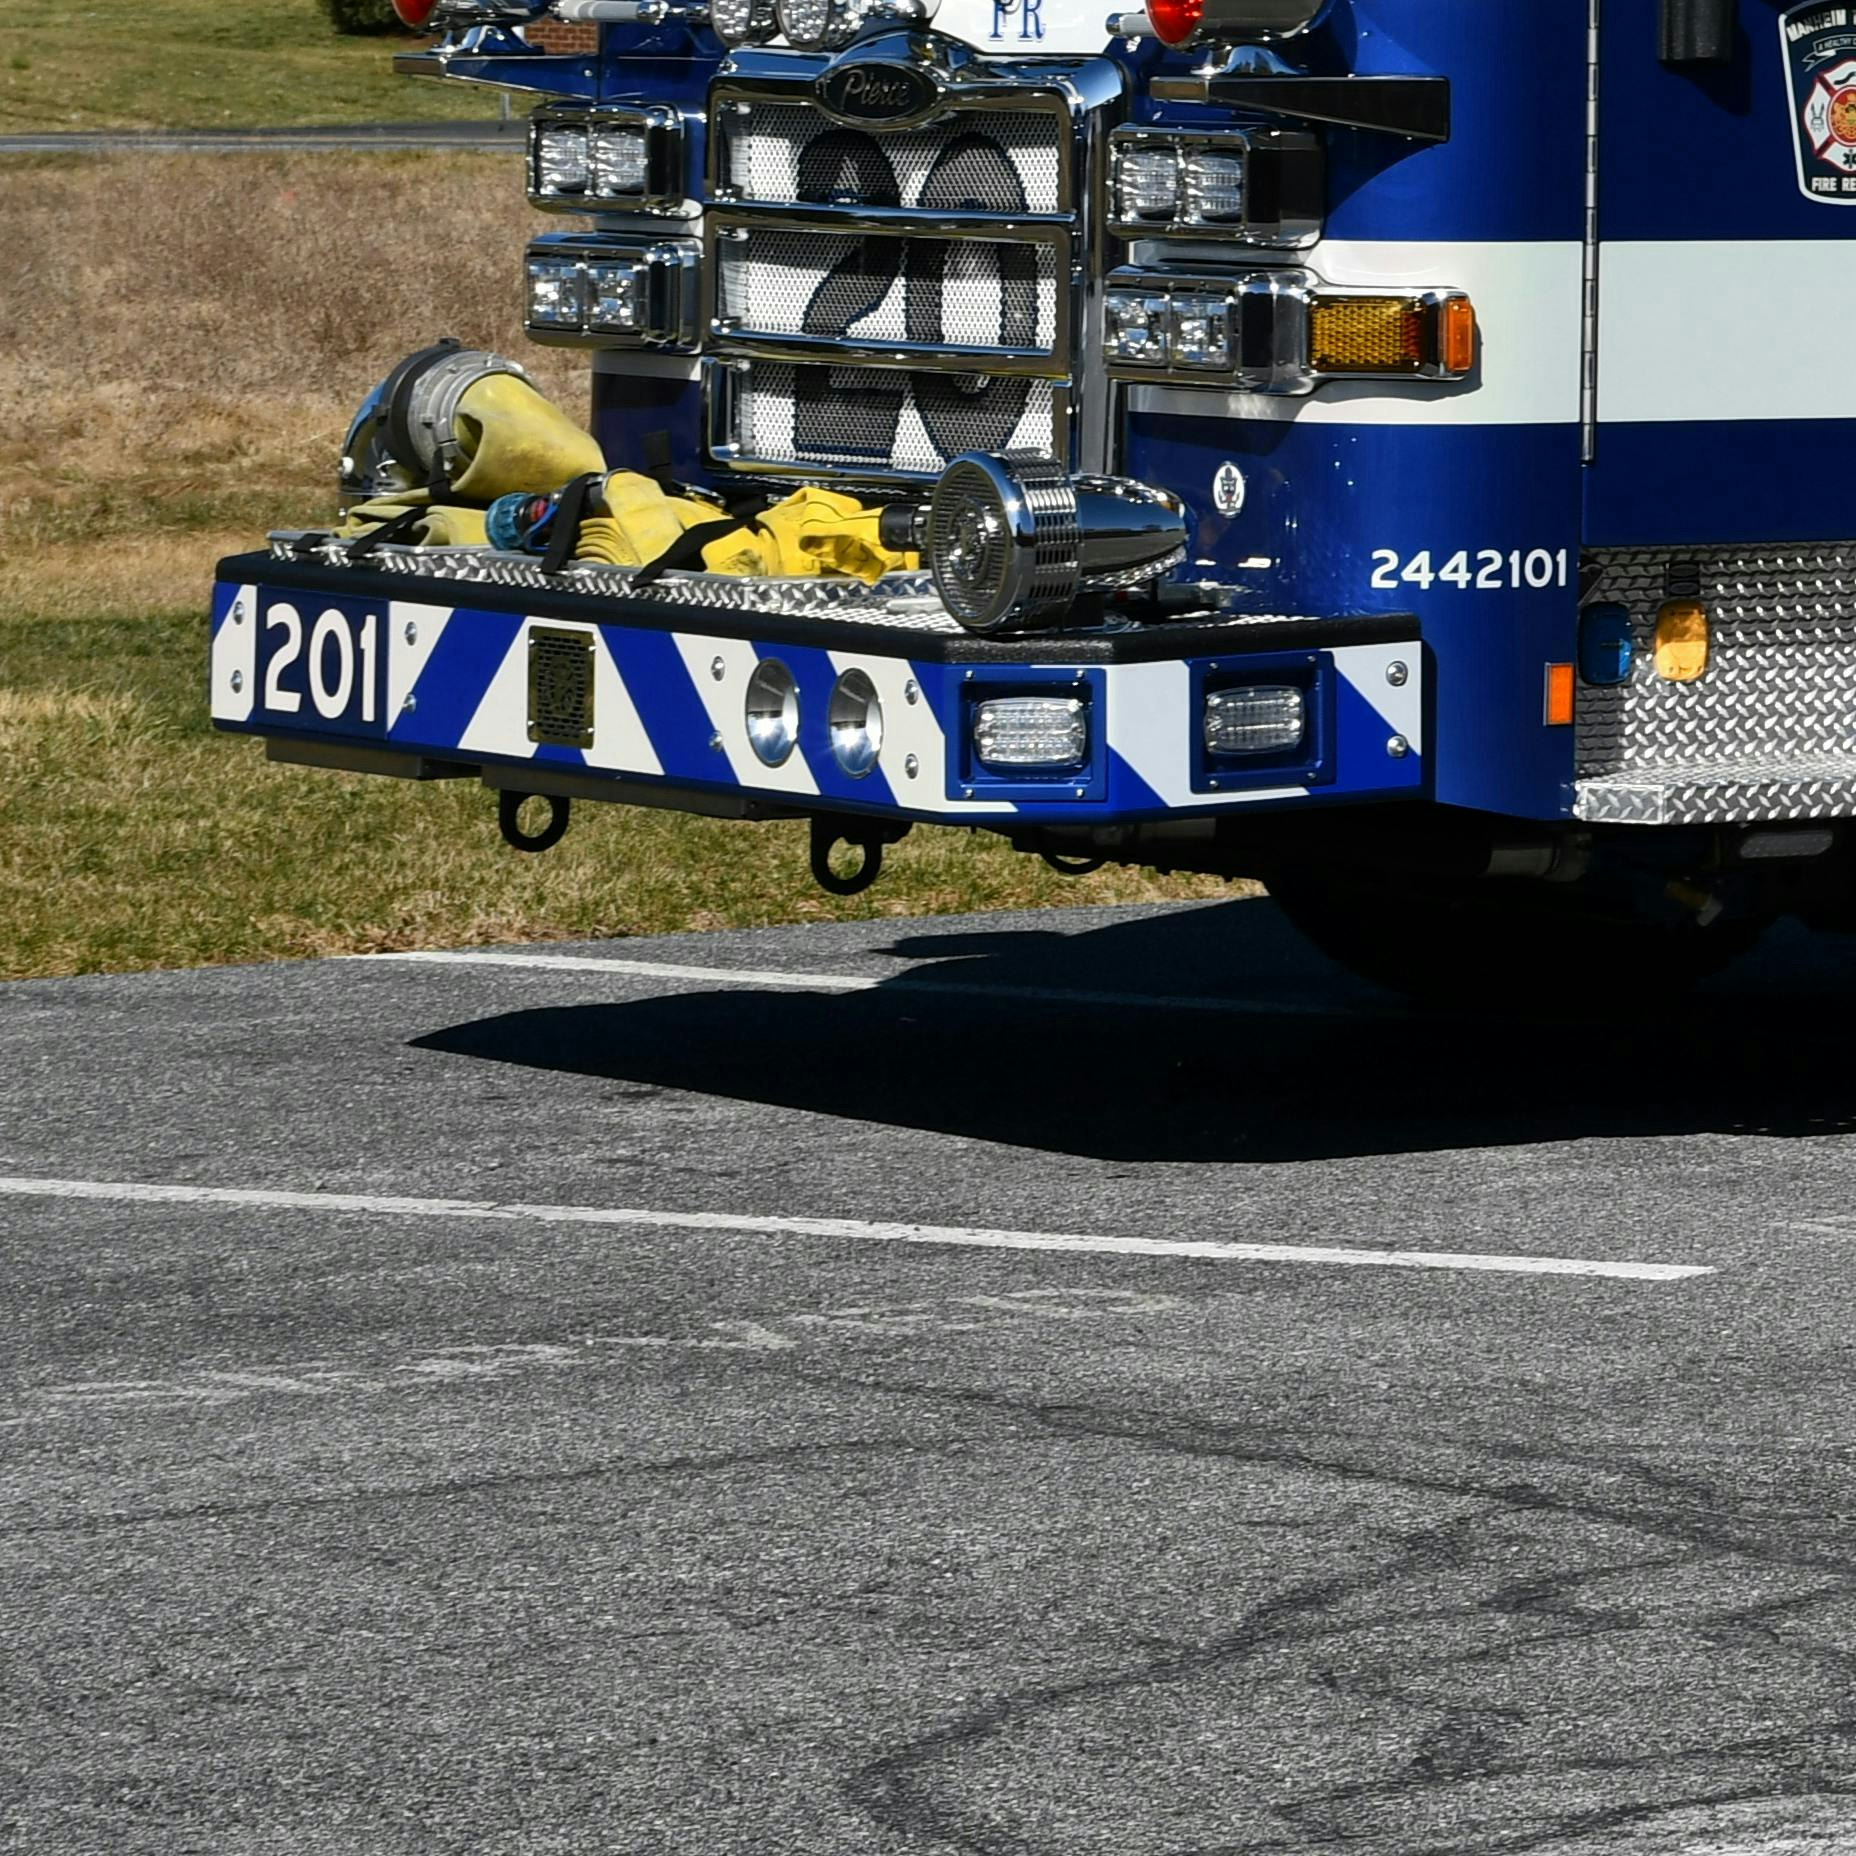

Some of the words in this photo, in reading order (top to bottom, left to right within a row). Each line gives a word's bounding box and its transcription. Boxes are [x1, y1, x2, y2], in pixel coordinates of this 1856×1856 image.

[1786, 9, 1846, 42] MANHEIM
[840, 69, 911, 111] Pierce
[1811, 176, 1837, 196] FIRE
[1371, 548, 1567, 589] 2442101
[264, 602, 377, 722] 201
